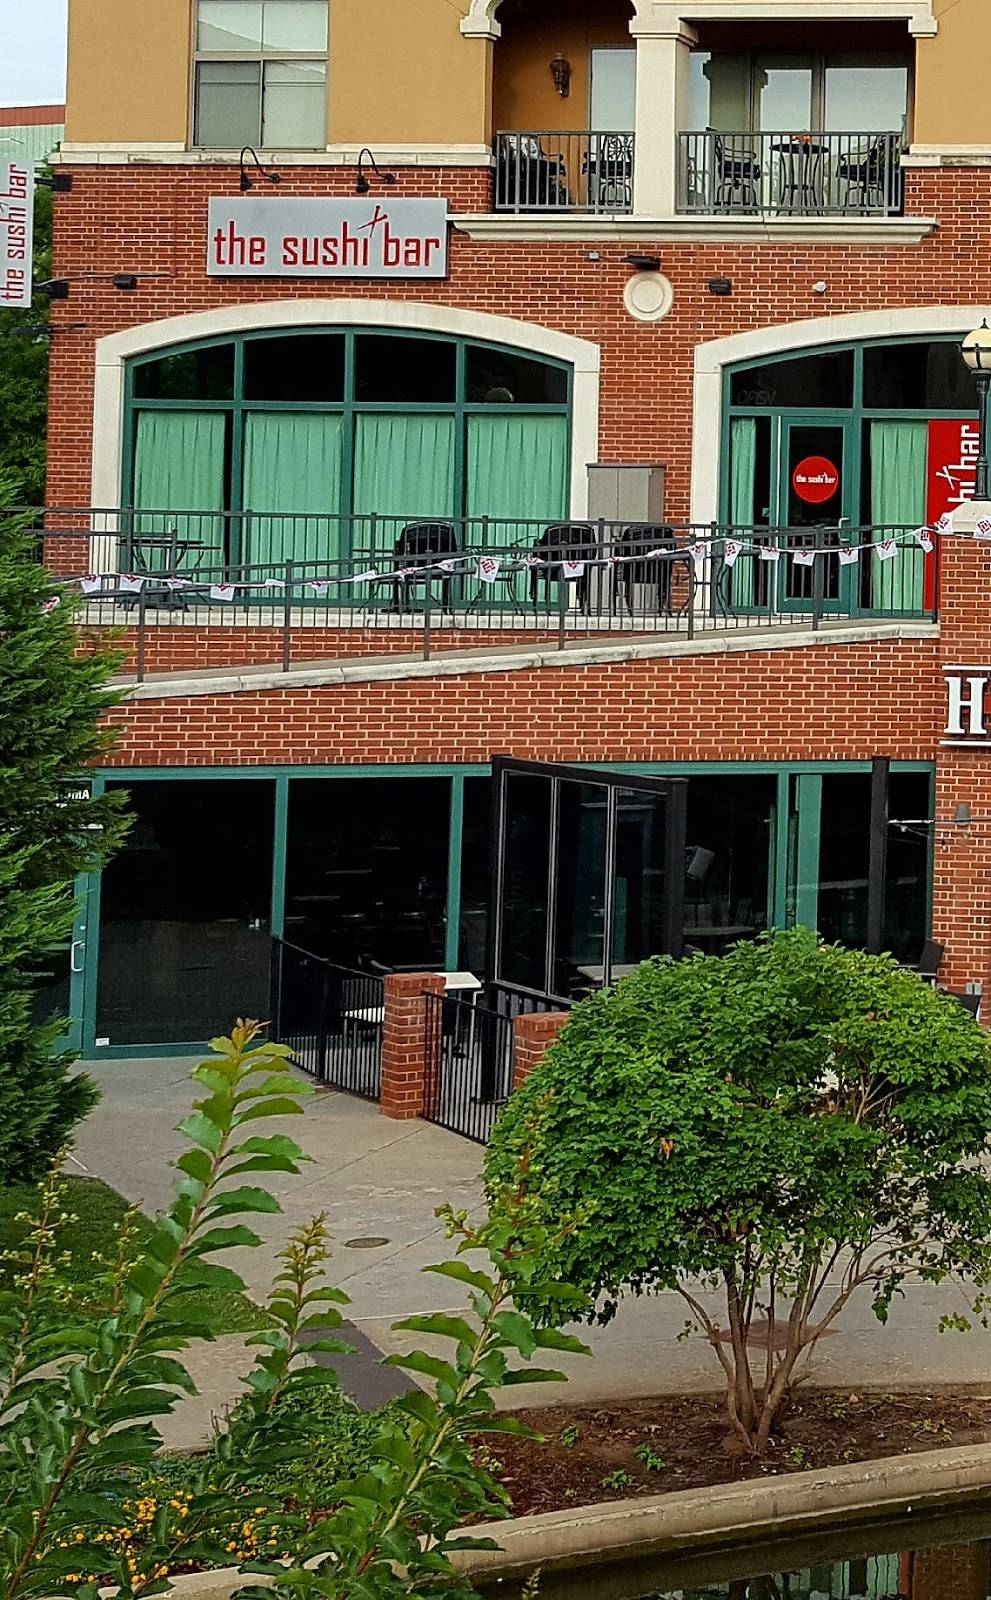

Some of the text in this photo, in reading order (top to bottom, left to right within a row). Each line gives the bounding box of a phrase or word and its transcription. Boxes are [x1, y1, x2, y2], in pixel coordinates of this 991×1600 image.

[0, 164, 27, 300] the sushi bar
[214, 220, 440, 267] the sushi bar
[795, 473, 836, 484] the sushi bar
